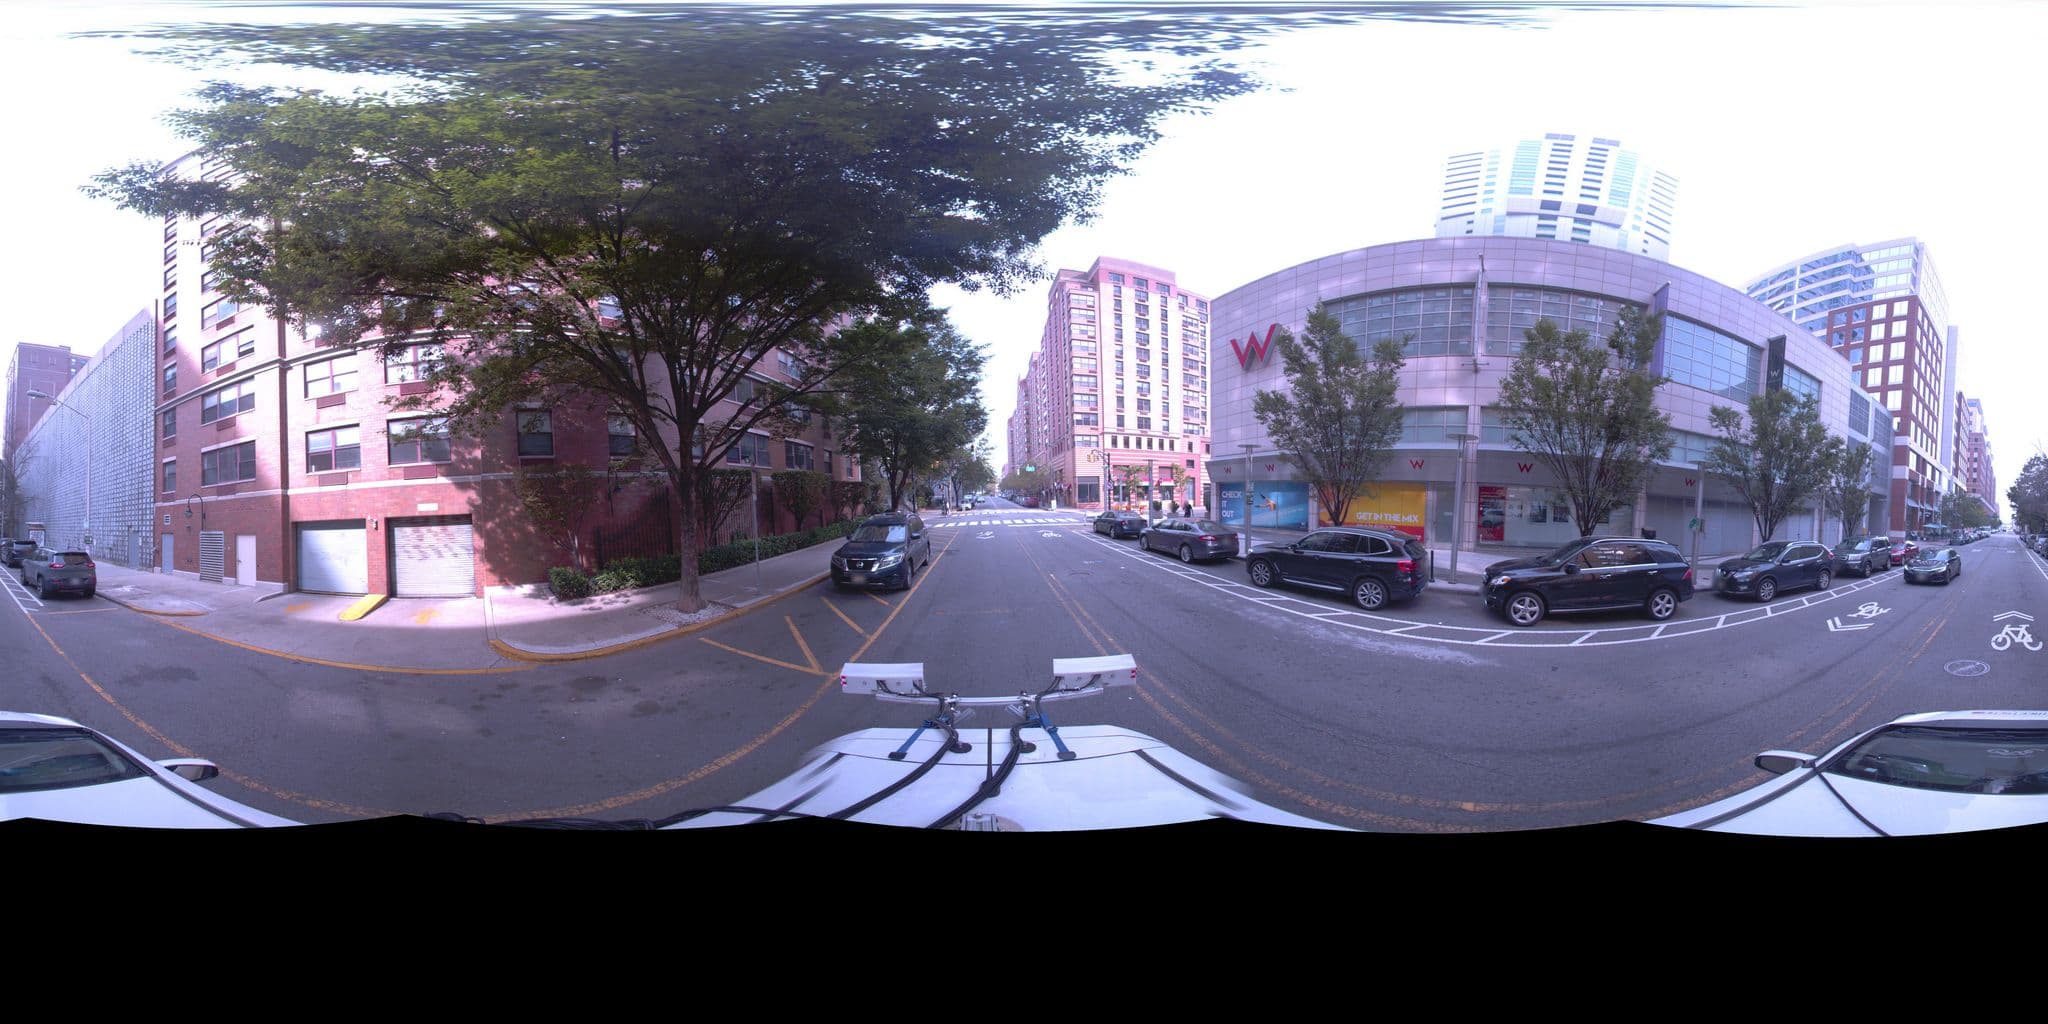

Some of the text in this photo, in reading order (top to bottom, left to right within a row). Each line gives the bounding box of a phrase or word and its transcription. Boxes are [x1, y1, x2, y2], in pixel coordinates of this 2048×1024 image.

[1229, 323, 1279, 371] W
[1265, 463, 1276, 472] W
[1410, 459, 1425, 470] W
[1517, 463, 1534, 473] W
[1685, 477, 1696, 487] W
[1221, 490, 1242, 499] CHECK
[1221, 510, 1234, 518] OUT
[1355, 512, 1419, 523] GET IN THE MIX
